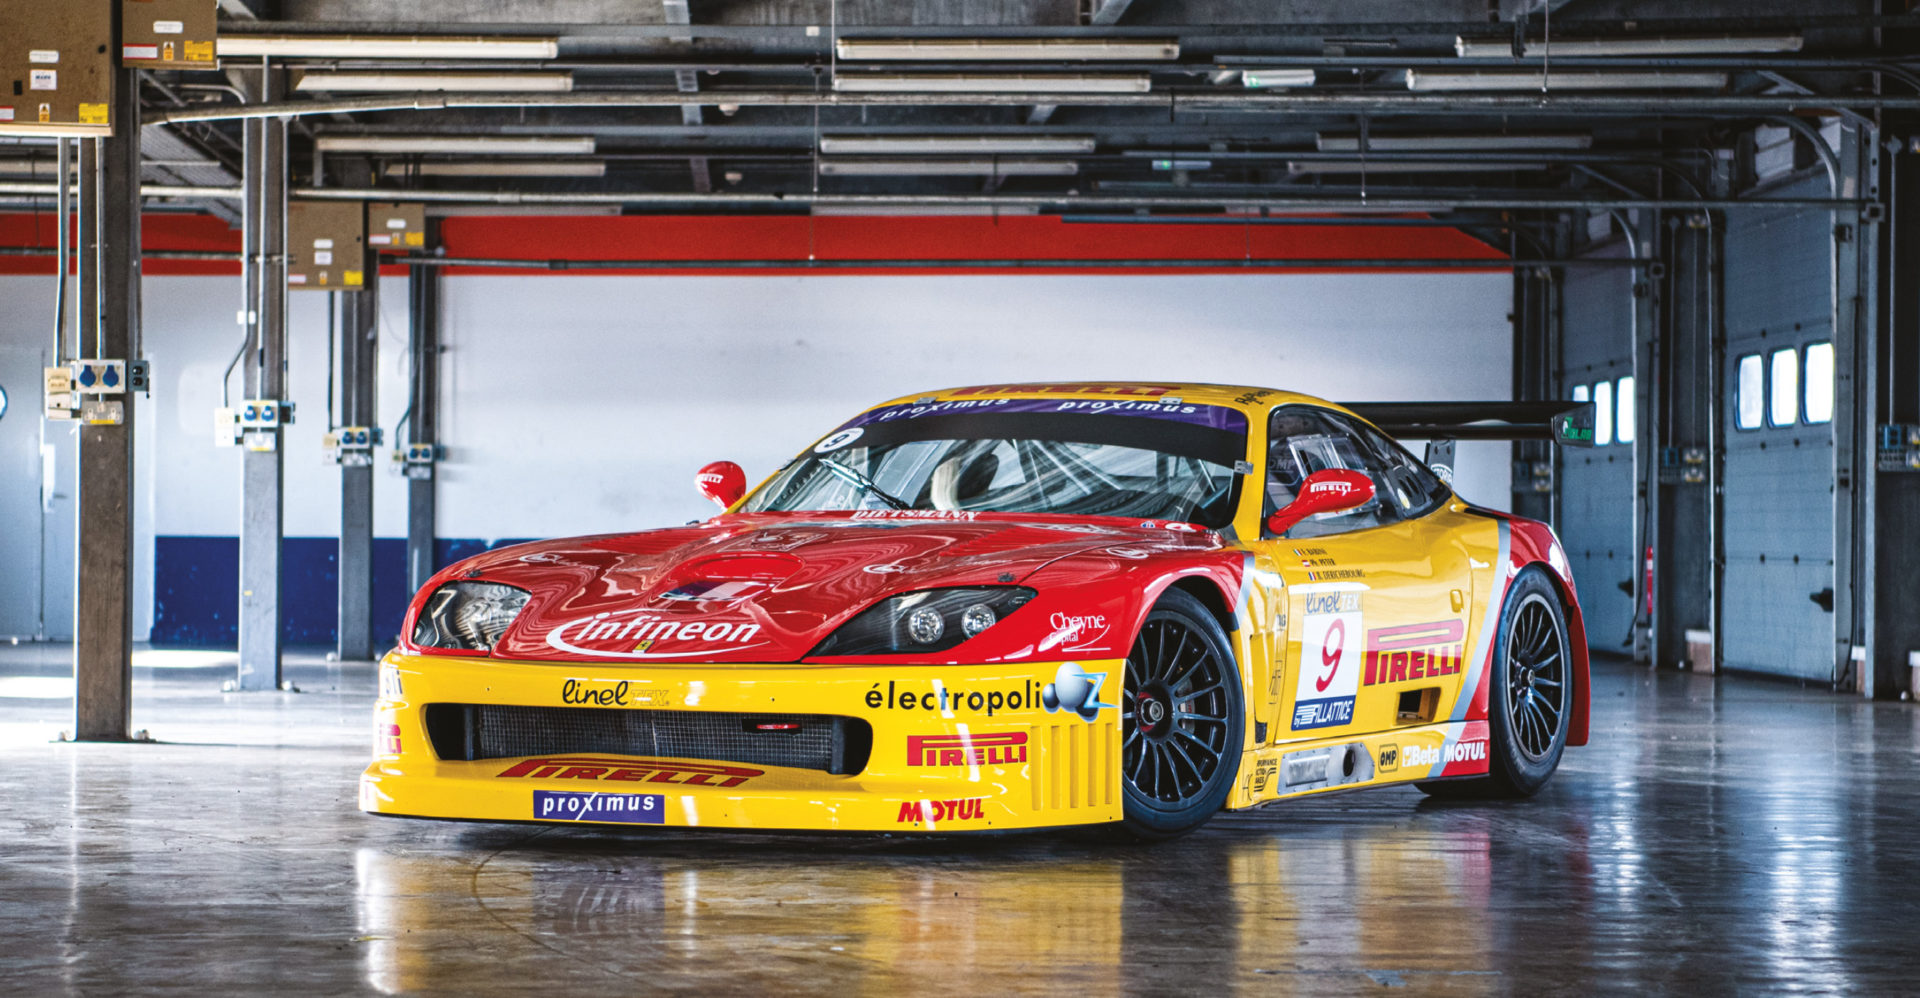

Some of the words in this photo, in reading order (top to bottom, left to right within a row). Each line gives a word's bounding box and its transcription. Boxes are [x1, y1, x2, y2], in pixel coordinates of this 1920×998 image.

[878, 398, 1011, 422] proximus
[1057, 400, 1198, 414] proximus
[823, 434, 850, 448] 9
[1310, 481, 1352, 494] PIRELLI
[850, 510, 980, 521] DIETSMANN
[1306, 590, 1340, 614] linel
[574, 612, 761, 643] infineon
[1050, 611, 1105, 634] Cheyne
[1315, 618, 1346, 692] 9
[1363, 618, 1465, 686] PIRELLI
[562, 678, 629, 706] linel
[865, 679, 1041, 717] électropoli
[907, 731, 1029, 766] PIRELLI
[1380, 750, 1397, 766] OMP
[1410, 744, 1440, 766] Beta
[1444, 742, 1486, 763] MOTUL
[495, 757, 766, 788] PIRELLI
[542, 792, 655, 821] proximus
[897, 798, 984, 823] MOTUL
